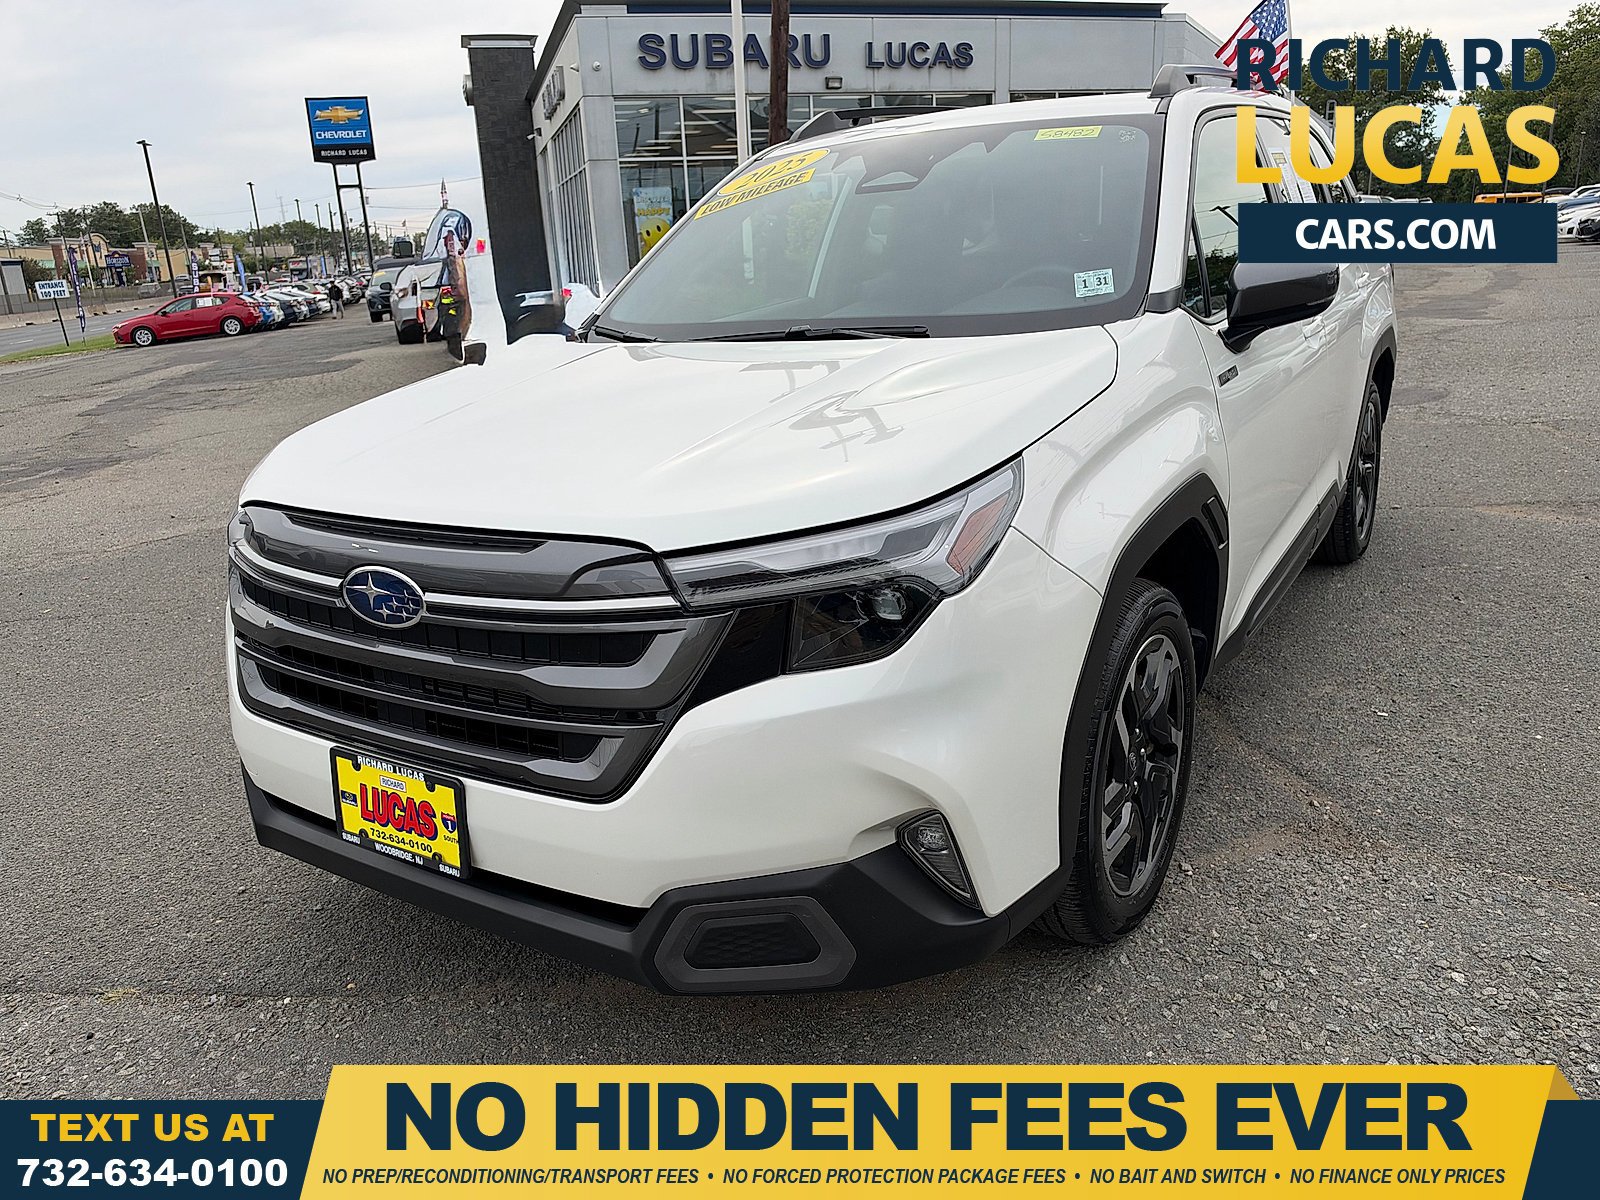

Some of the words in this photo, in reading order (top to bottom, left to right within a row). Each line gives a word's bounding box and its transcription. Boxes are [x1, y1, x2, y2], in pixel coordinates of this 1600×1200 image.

[638, 32, 831, 69] SUBARU
[865, 41, 975, 69] LUCAS
[315, 129, 367, 139] CHEVROLET
[320, 149, 347, 157] RICHARD
[735, 152, 814, 191] 2025
[700, 198, 734, 216] LOW
[735, 171, 809, 203] MILEAGE
[38, 281, 65, 290] ENTRANCE
[1082, 279, 1088, 289] 1
[1095, 276, 1109, 287] 31
[53, 290, 66, 298] FEET
[357, 755, 394, 774] RICHARD
[395, 766, 425, 782] LUCAS
[381, 777, 405, 791] RICHARD
[359, 783, 439, 842] LUCAS
[446, 820, 453, 832] 1
[341, 831, 361, 845] SUBARU
[370, 827, 433, 854] 732-634-0100
[415, 855, 424, 866] NJ
[438, 863, 460, 878] SUBARU
